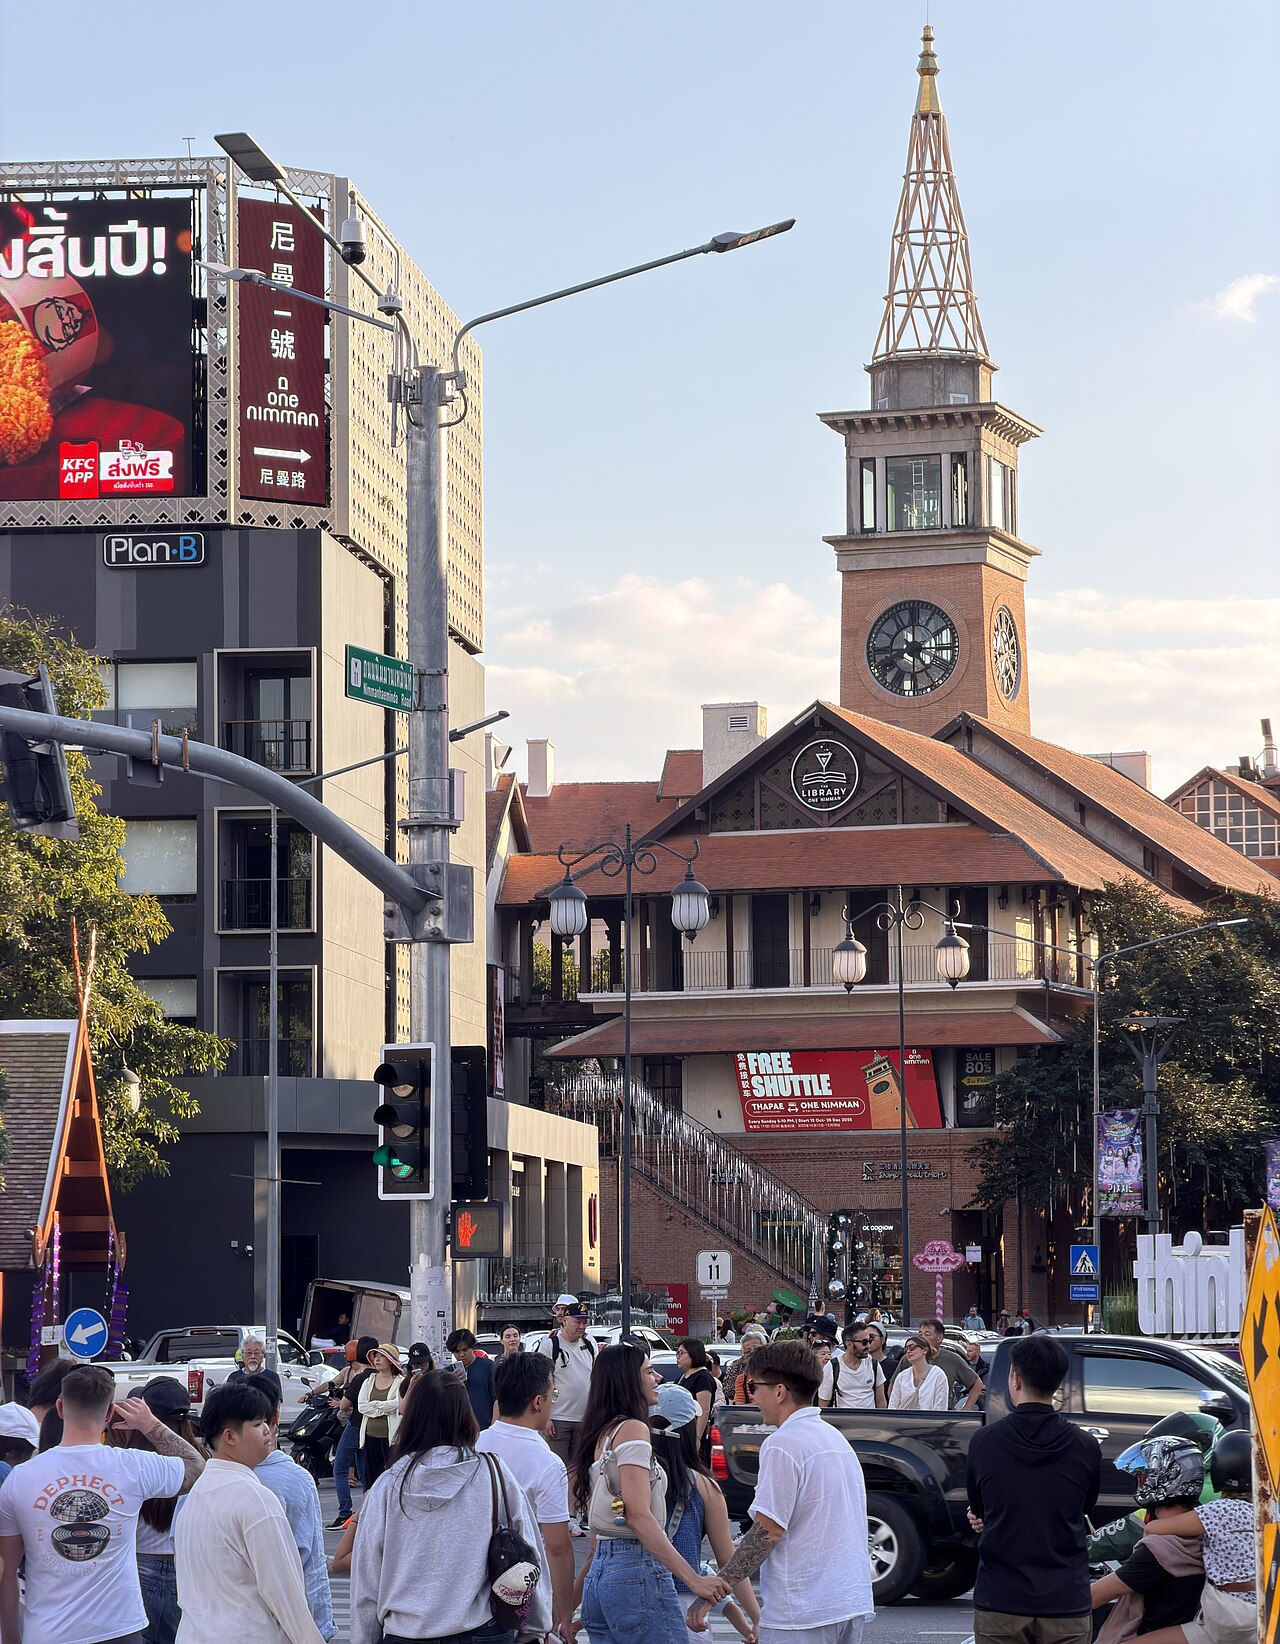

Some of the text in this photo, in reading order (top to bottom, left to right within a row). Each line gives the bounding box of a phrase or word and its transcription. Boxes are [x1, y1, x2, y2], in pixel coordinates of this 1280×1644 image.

[267, 391, 299, 408] one
[61, 458, 96, 470] KFC
[108, 457, 160, 477] ส่งฟรี
[63, 472, 94, 483] APP
[260, 468, 306, 489] 尼曼路
[802, 788, 846, 797] LIBRARY
[746, 1052, 793, 1074] FREE
[965, 1053, 992, 1062] SALE
[751, 1074, 832, 1097] SHUTTLE
[751, 1102, 784, 1111] THAPAE
[800, 1101, 859, 1110] ONE NIMMAN
[1108, 1183, 1133, 1193] PIXXIE
[708, 1264, 720, 1280] 11
[33, 1474, 125, 1511] DEPHECT
